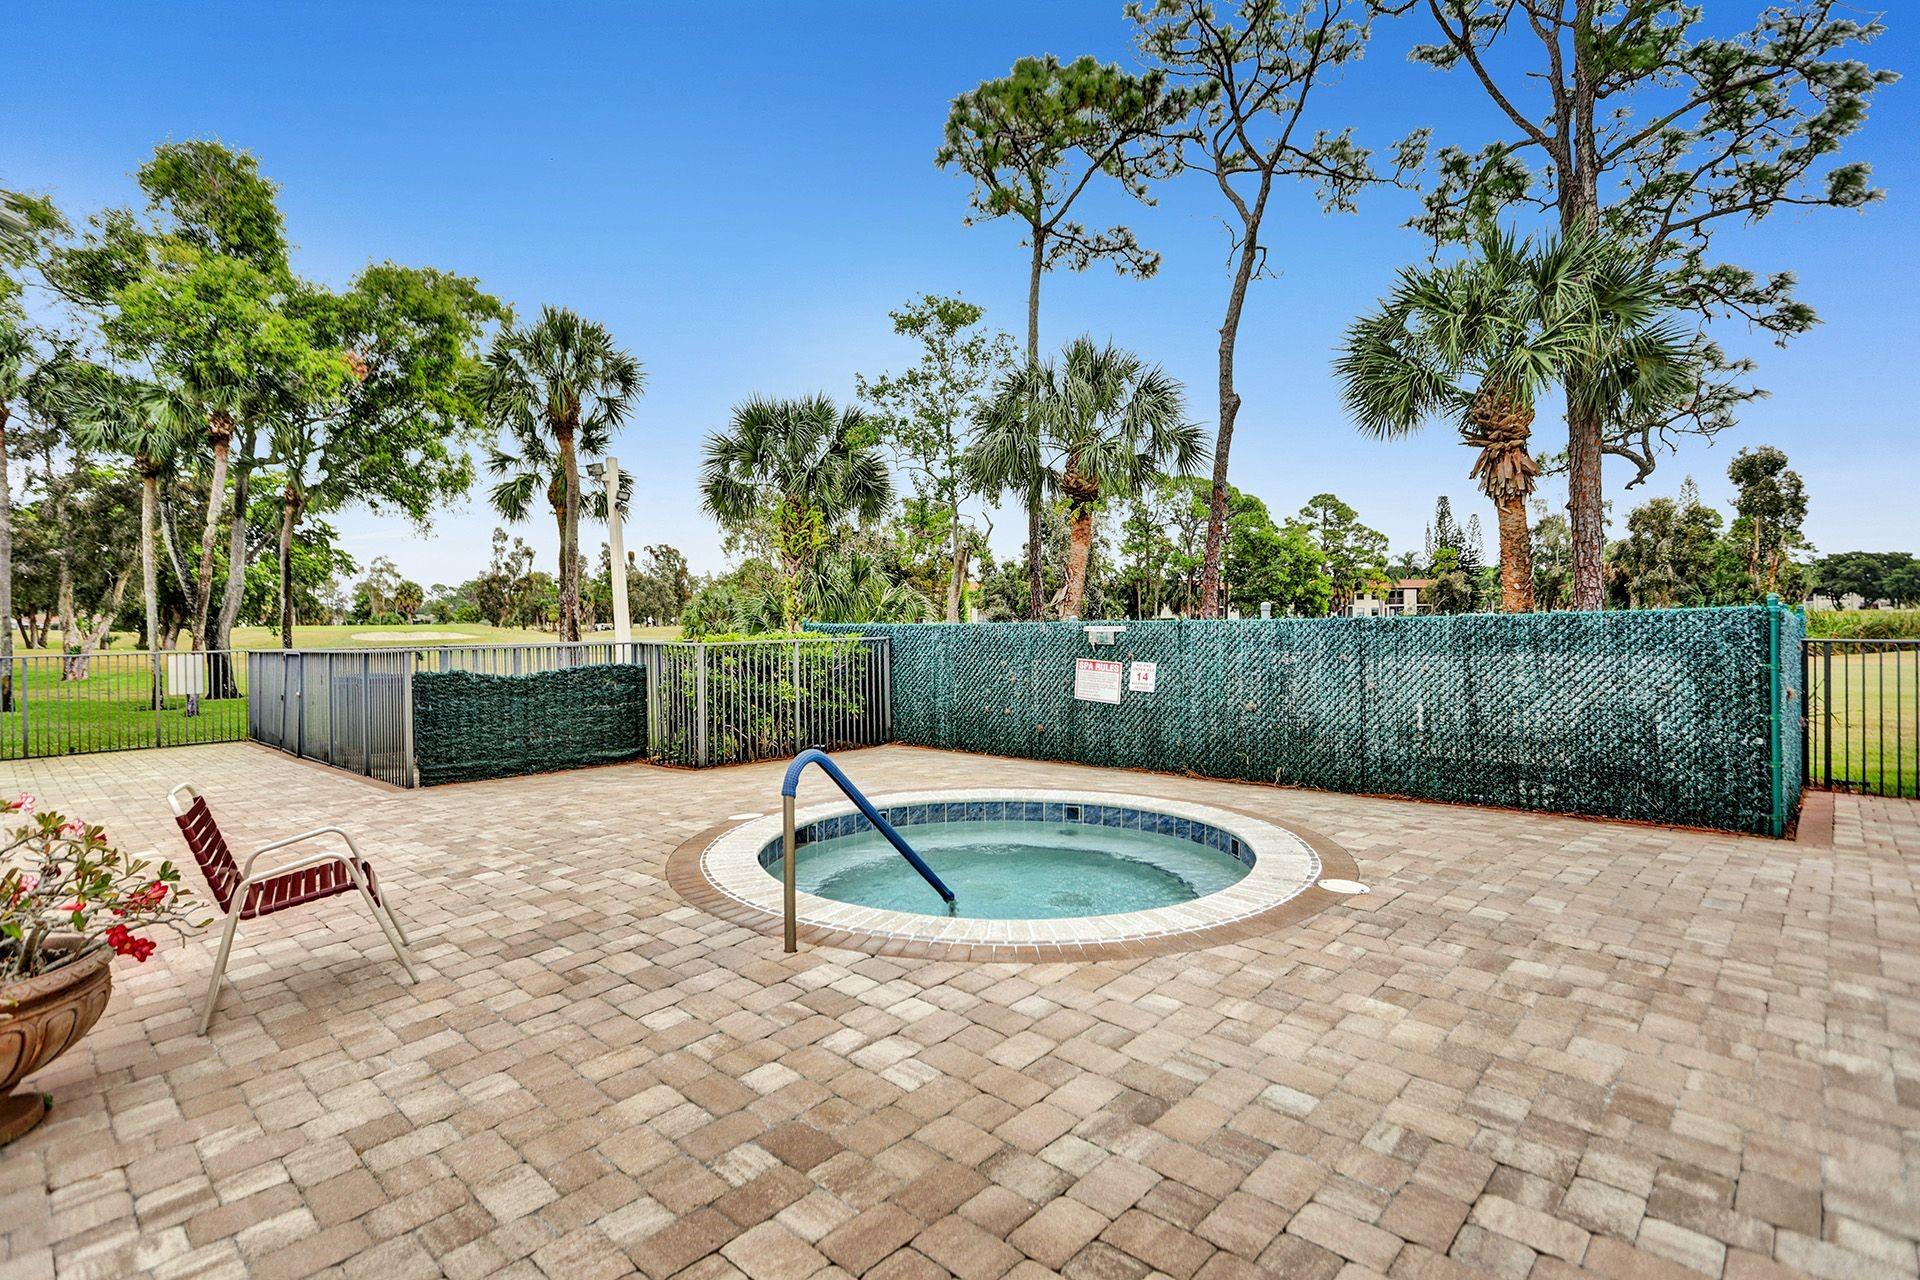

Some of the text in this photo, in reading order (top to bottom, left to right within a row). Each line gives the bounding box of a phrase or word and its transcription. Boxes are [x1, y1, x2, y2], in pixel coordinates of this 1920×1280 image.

[1079, 661, 1119, 672] SPA RULES
[1137, 672, 1148, 681] 14
